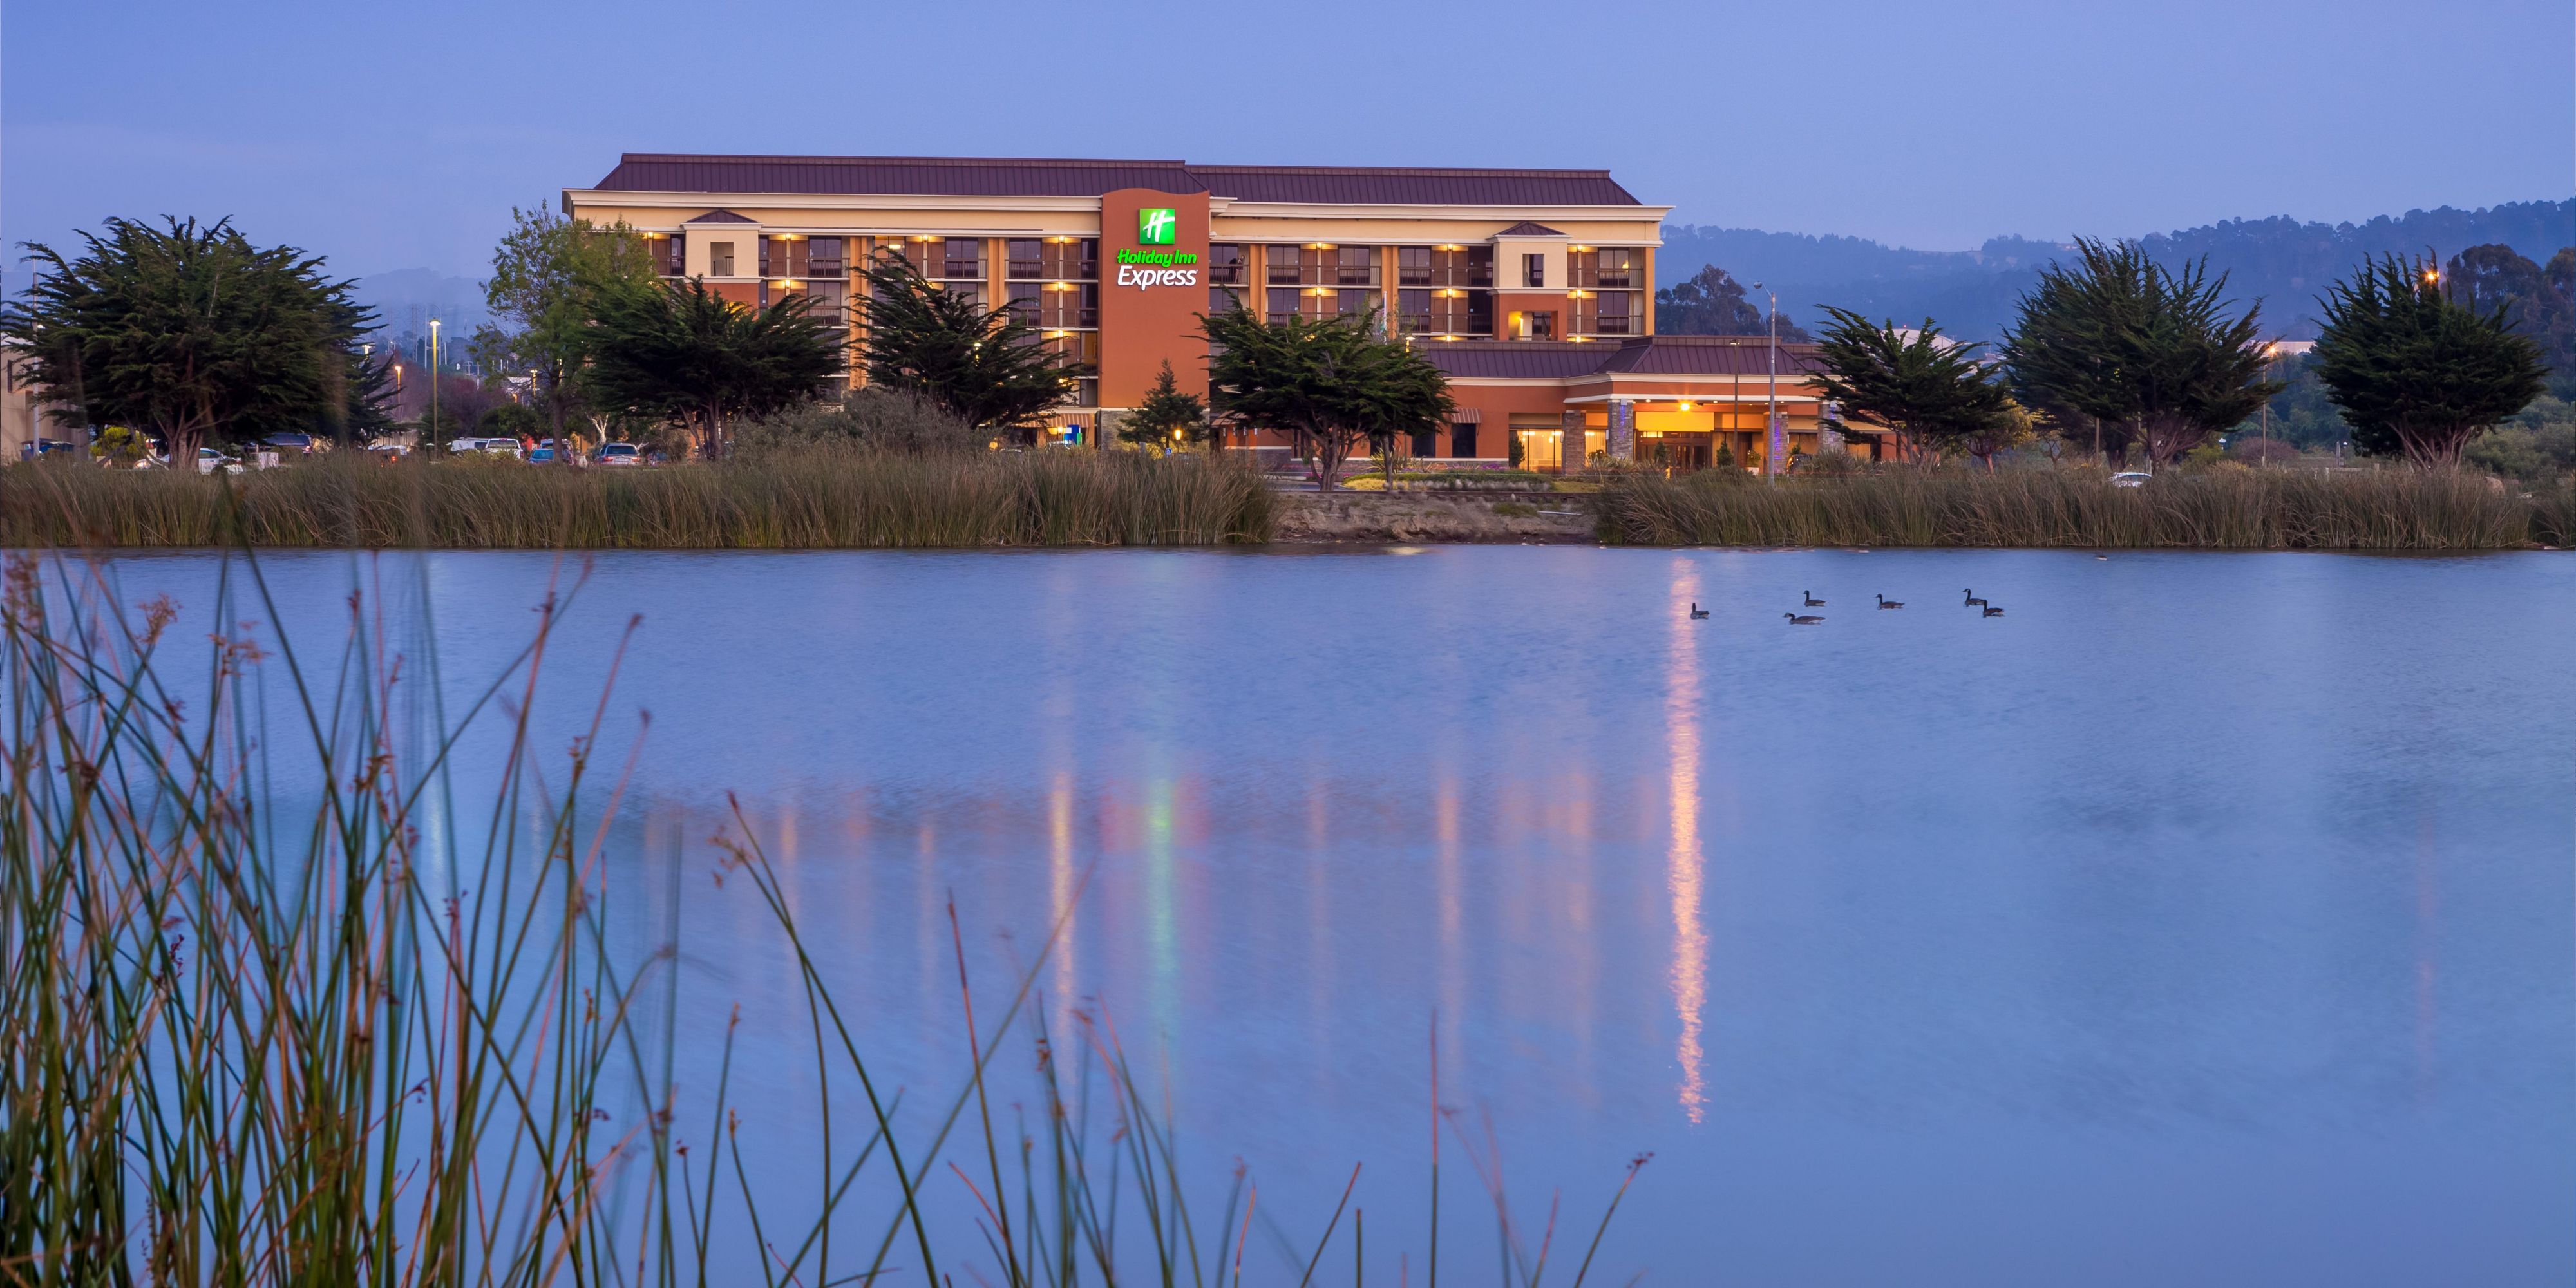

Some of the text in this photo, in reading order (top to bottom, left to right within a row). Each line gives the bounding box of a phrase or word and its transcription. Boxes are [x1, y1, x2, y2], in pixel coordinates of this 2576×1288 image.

[1143, 210, 1175, 242] H
[1117, 249, 1197, 267] Holiday Inn
[1117, 265, 1197, 290] Express
